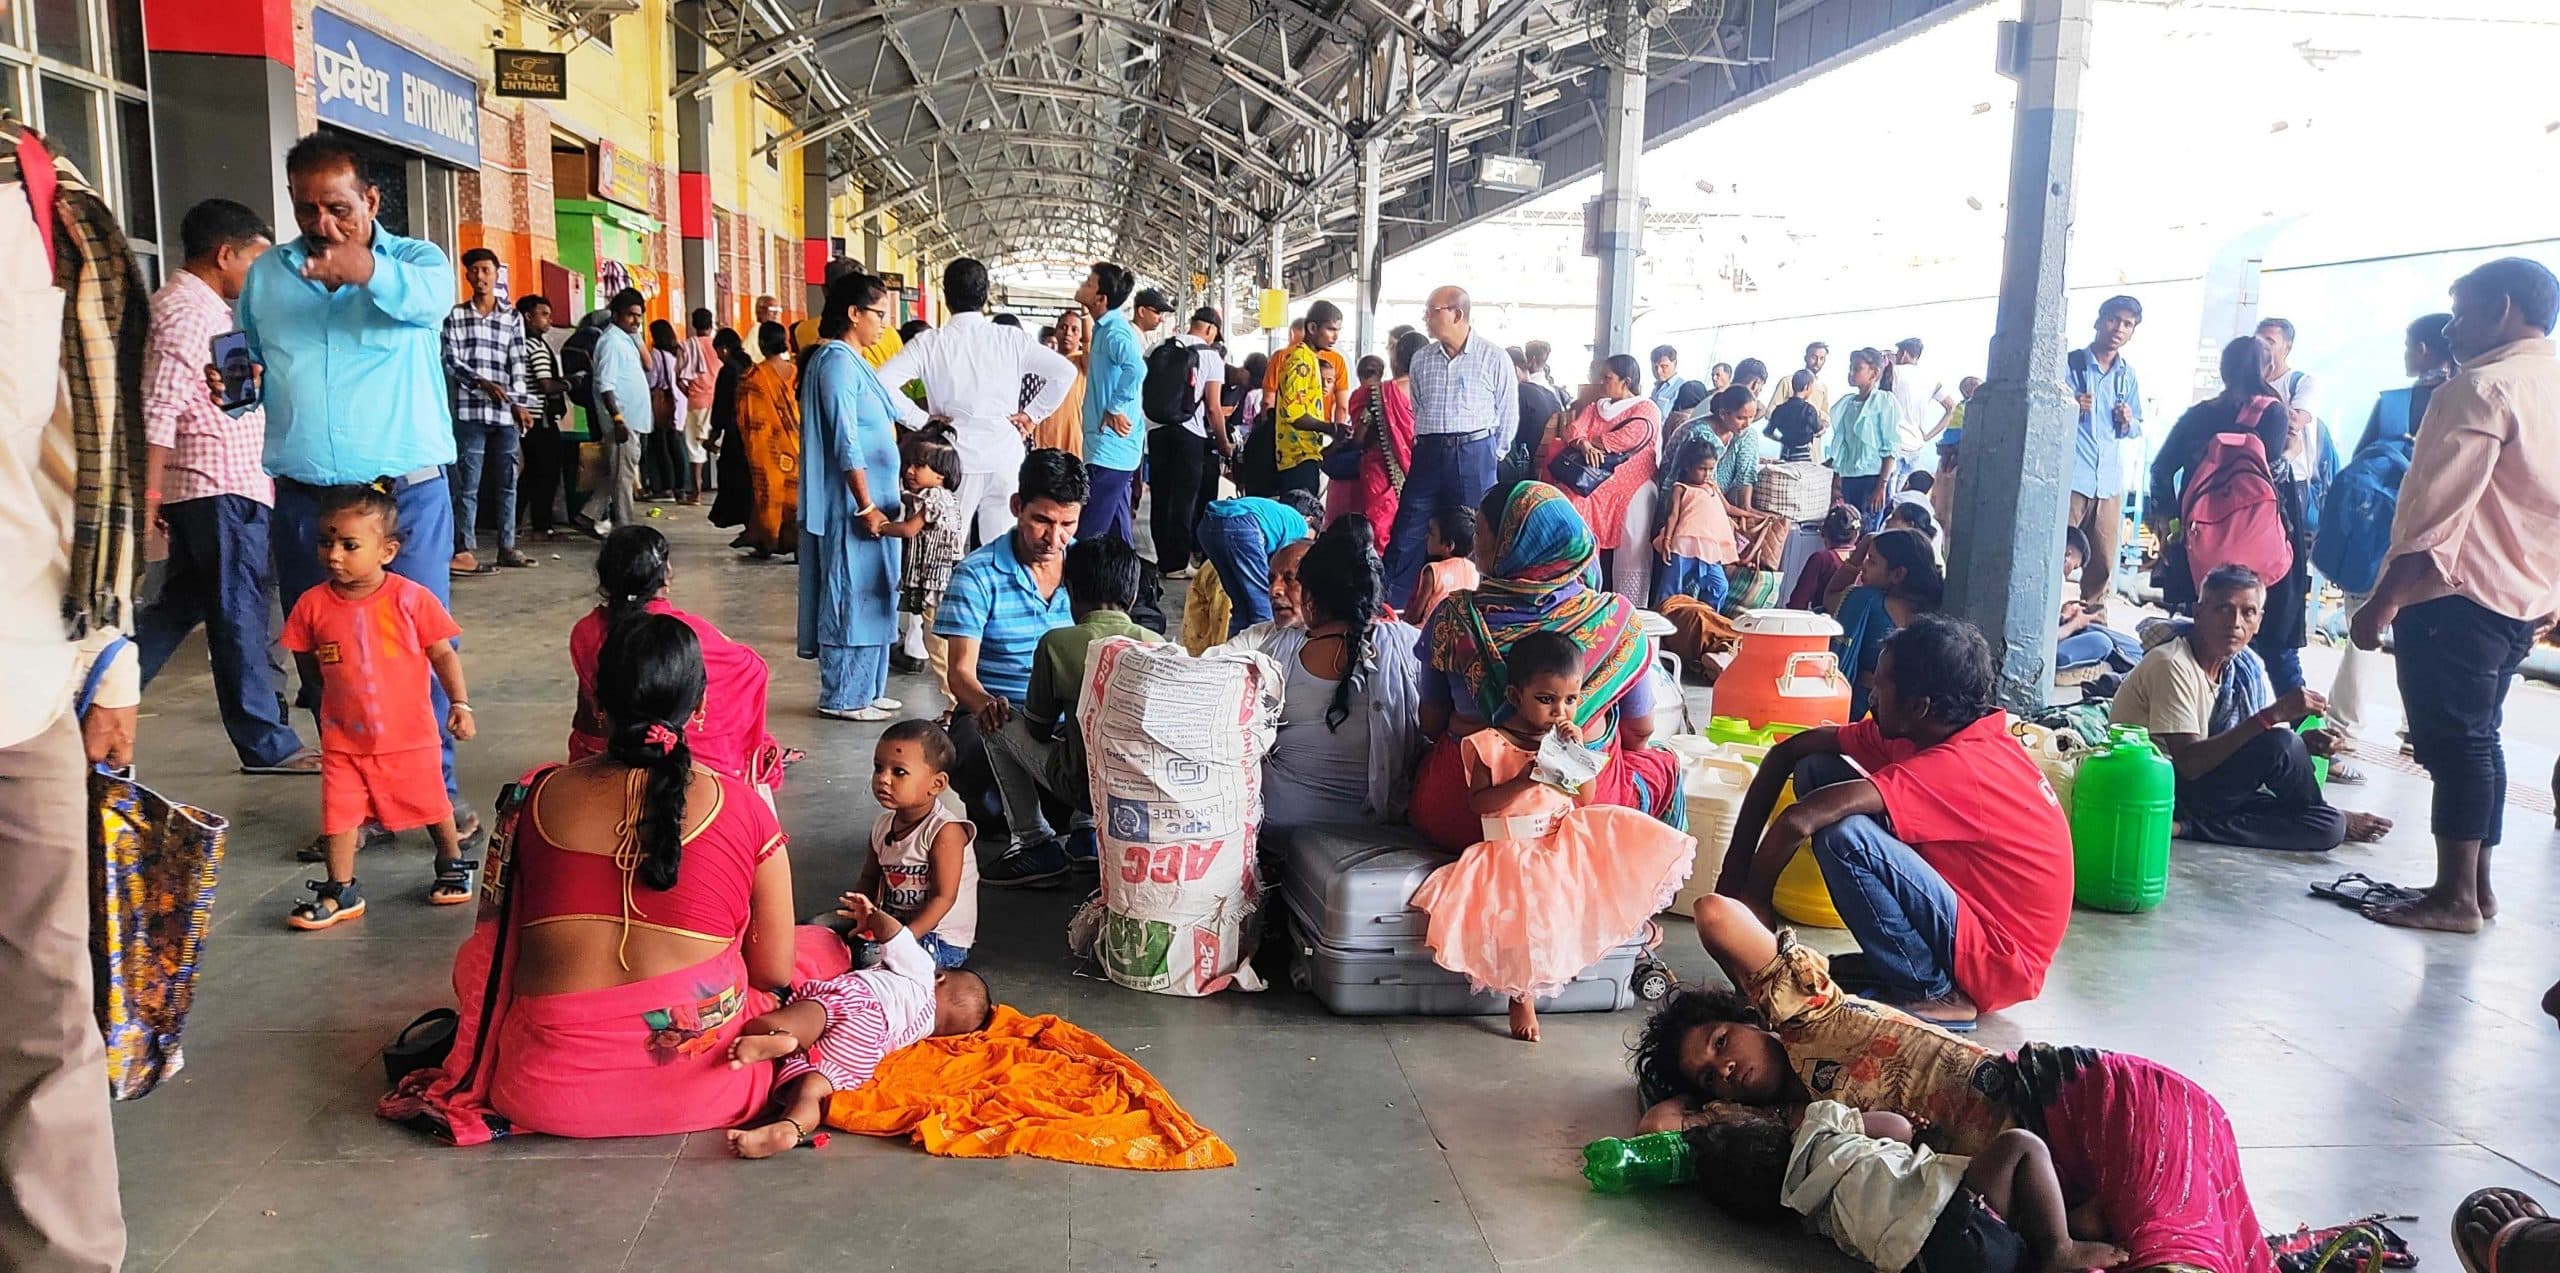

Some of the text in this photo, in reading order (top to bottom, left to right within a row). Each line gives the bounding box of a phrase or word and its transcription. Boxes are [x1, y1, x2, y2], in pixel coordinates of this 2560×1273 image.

[314, 40, 391, 116] प्रवेश
[501, 80, 560, 92] ENTRANCE
[402, 72, 475, 146] ENTRANCE
[1152, 804, 1220, 819] LONG LIFE
[1166, 820, 1211, 835] HPC
[1121, 840, 1224, 884] ACC
